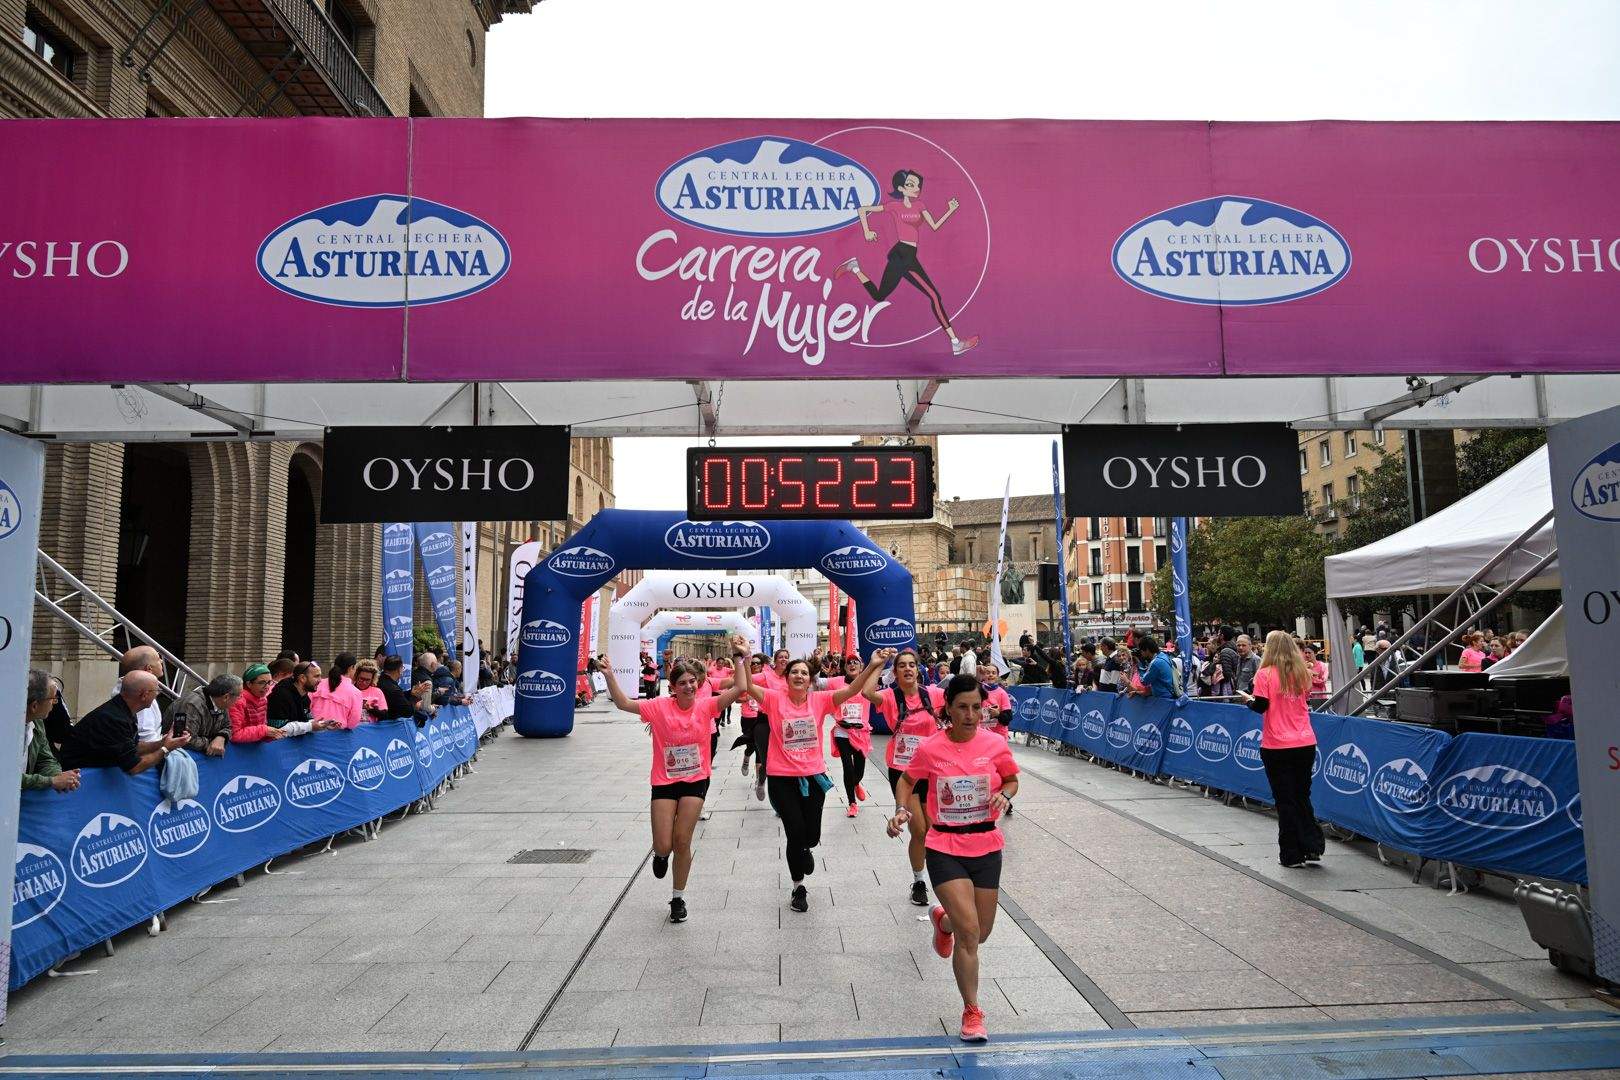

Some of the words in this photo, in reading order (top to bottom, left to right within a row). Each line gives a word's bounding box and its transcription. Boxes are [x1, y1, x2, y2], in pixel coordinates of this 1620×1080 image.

[672, 172, 861, 211] ASTURIANA
[708, 171, 778, 181] CENTRAL
[785, 171, 855, 181] LECHERA
[317, 234, 395, 245] CENTRAL
[403, 233, 483, 244] LECHERA
[1167, 234, 1241, 245] CENTRAL
[1250, 233, 1325, 244] LECHERA
[275, 236, 491, 279] ASTURIANA
[635, 229, 822, 283] Carrera
[1131, 237, 1334, 277] ASTURIANA
[680, 284, 716, 321] de
[723, 283, 749, 321] la
[742, 278, 893, 366] Mujer
[363, 457, 535, 492] OYSHO
[1102, 455, 1267, 489] OYSHO
[672, 529, 763, 548] ASTURIANA
[552, 557, 609, 570] ASTURIANA
[827, 558, 883, 570] ASTURIANA
[672, 581, 755, 599] OYSHO
[523, 630, 567, 642] ASTURIANA
[518, 680, 562, 692] ASTURIANA
[291, 776, 342, 801] ASTURIANA
[1442, 785, 1546, 818] ASTURIANA
[219, 794, 278, 825] ASTURIANA
[154, 816, 209, 848] ASTURIANA
[80, 837, 146, 878] ASTURIANA
